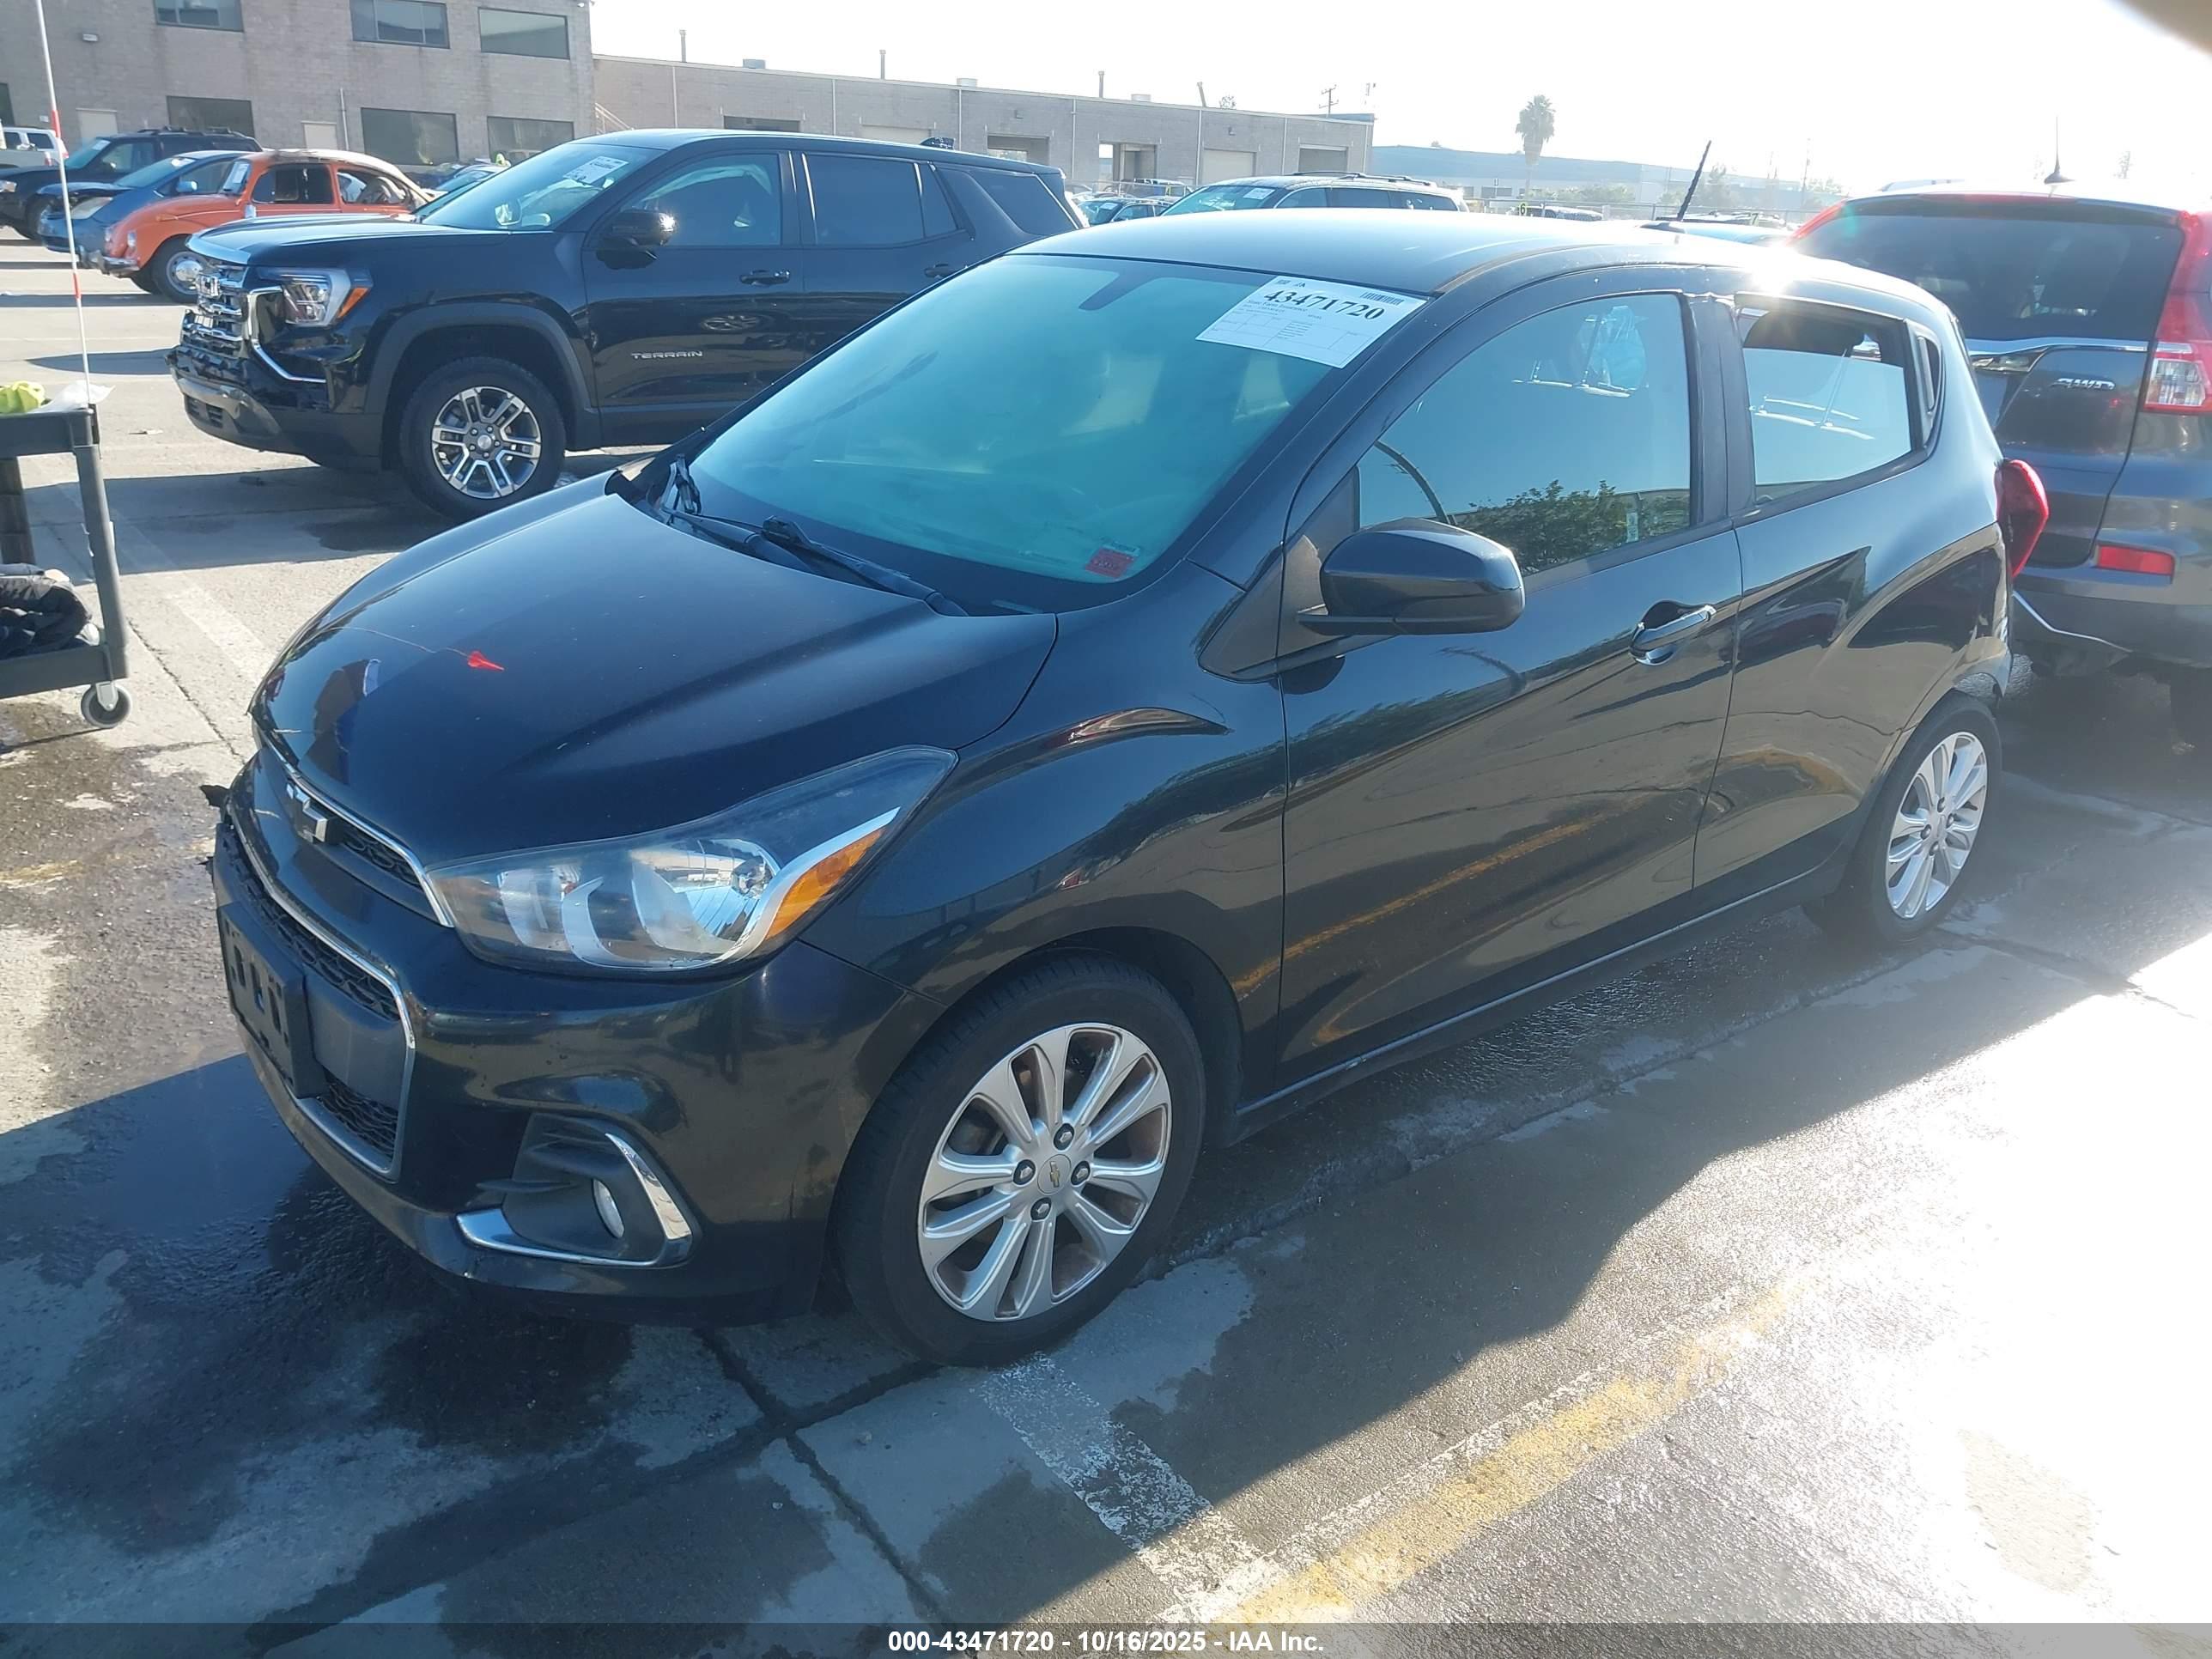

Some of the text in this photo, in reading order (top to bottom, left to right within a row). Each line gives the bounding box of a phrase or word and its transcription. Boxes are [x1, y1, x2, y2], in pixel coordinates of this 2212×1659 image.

[1519, 203, 1526, 216] 6
[1264, 289, 1384, 320] 43471720
[630, 350, 703, 360] TERRAIN
[2051, 378, 2115, 390] AWD
